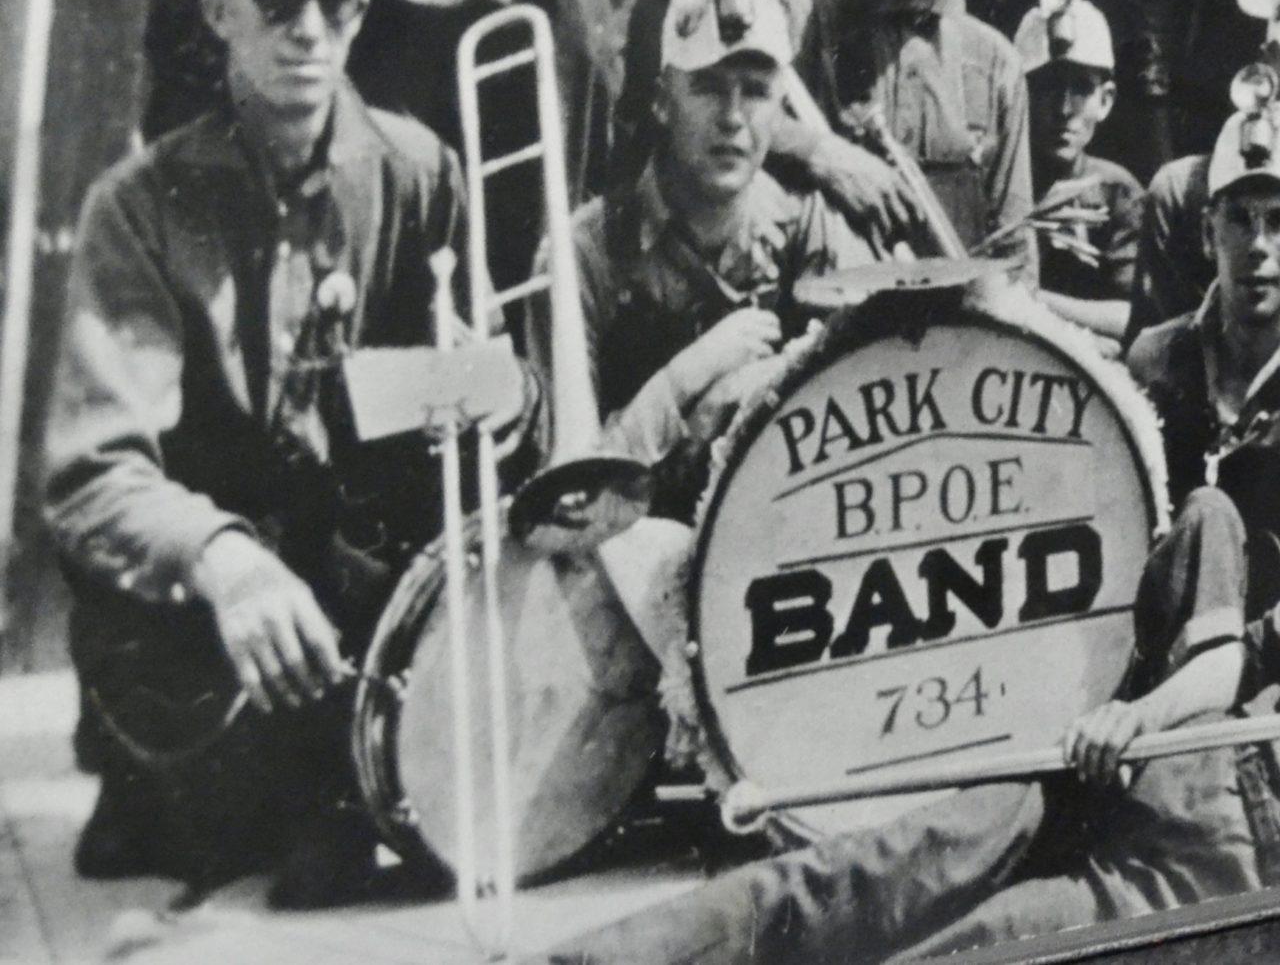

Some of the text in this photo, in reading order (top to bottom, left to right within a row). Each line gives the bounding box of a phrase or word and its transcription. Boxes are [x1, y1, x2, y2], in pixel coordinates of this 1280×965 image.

[777, 367, 1098, 475] PARK CITY
[833, 457, 1030, 539] B.P.O.E.
[745, 523, 1102, 676] BAND
[876, 665, 988, 737] 734
